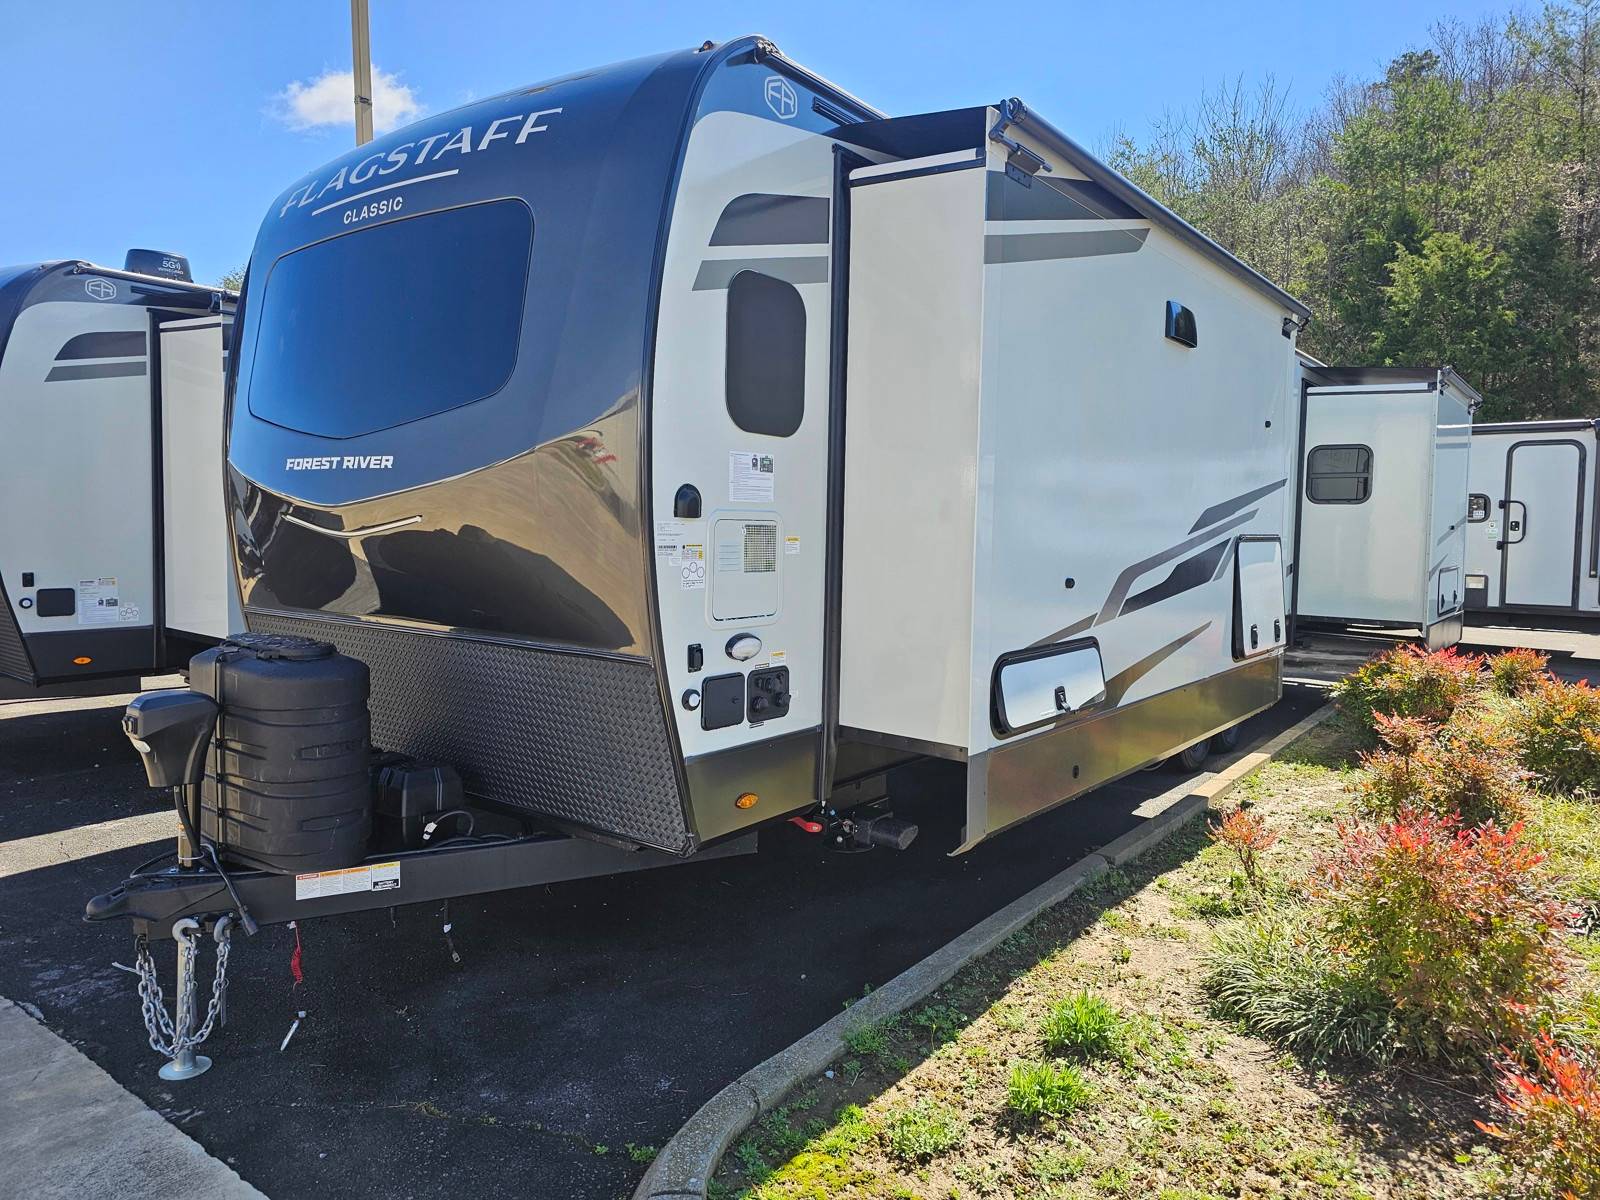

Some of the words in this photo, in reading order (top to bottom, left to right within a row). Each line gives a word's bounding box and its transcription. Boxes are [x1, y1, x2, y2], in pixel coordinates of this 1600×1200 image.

[280, 107, 563, 218] FLAGSTAFF
[343, 197, 403, 225] CLASSIC
[162, 260, 176, 269] 5G
[286, 457, 340, 470] FOREST
[343, 456, 394, 469] RIVER
